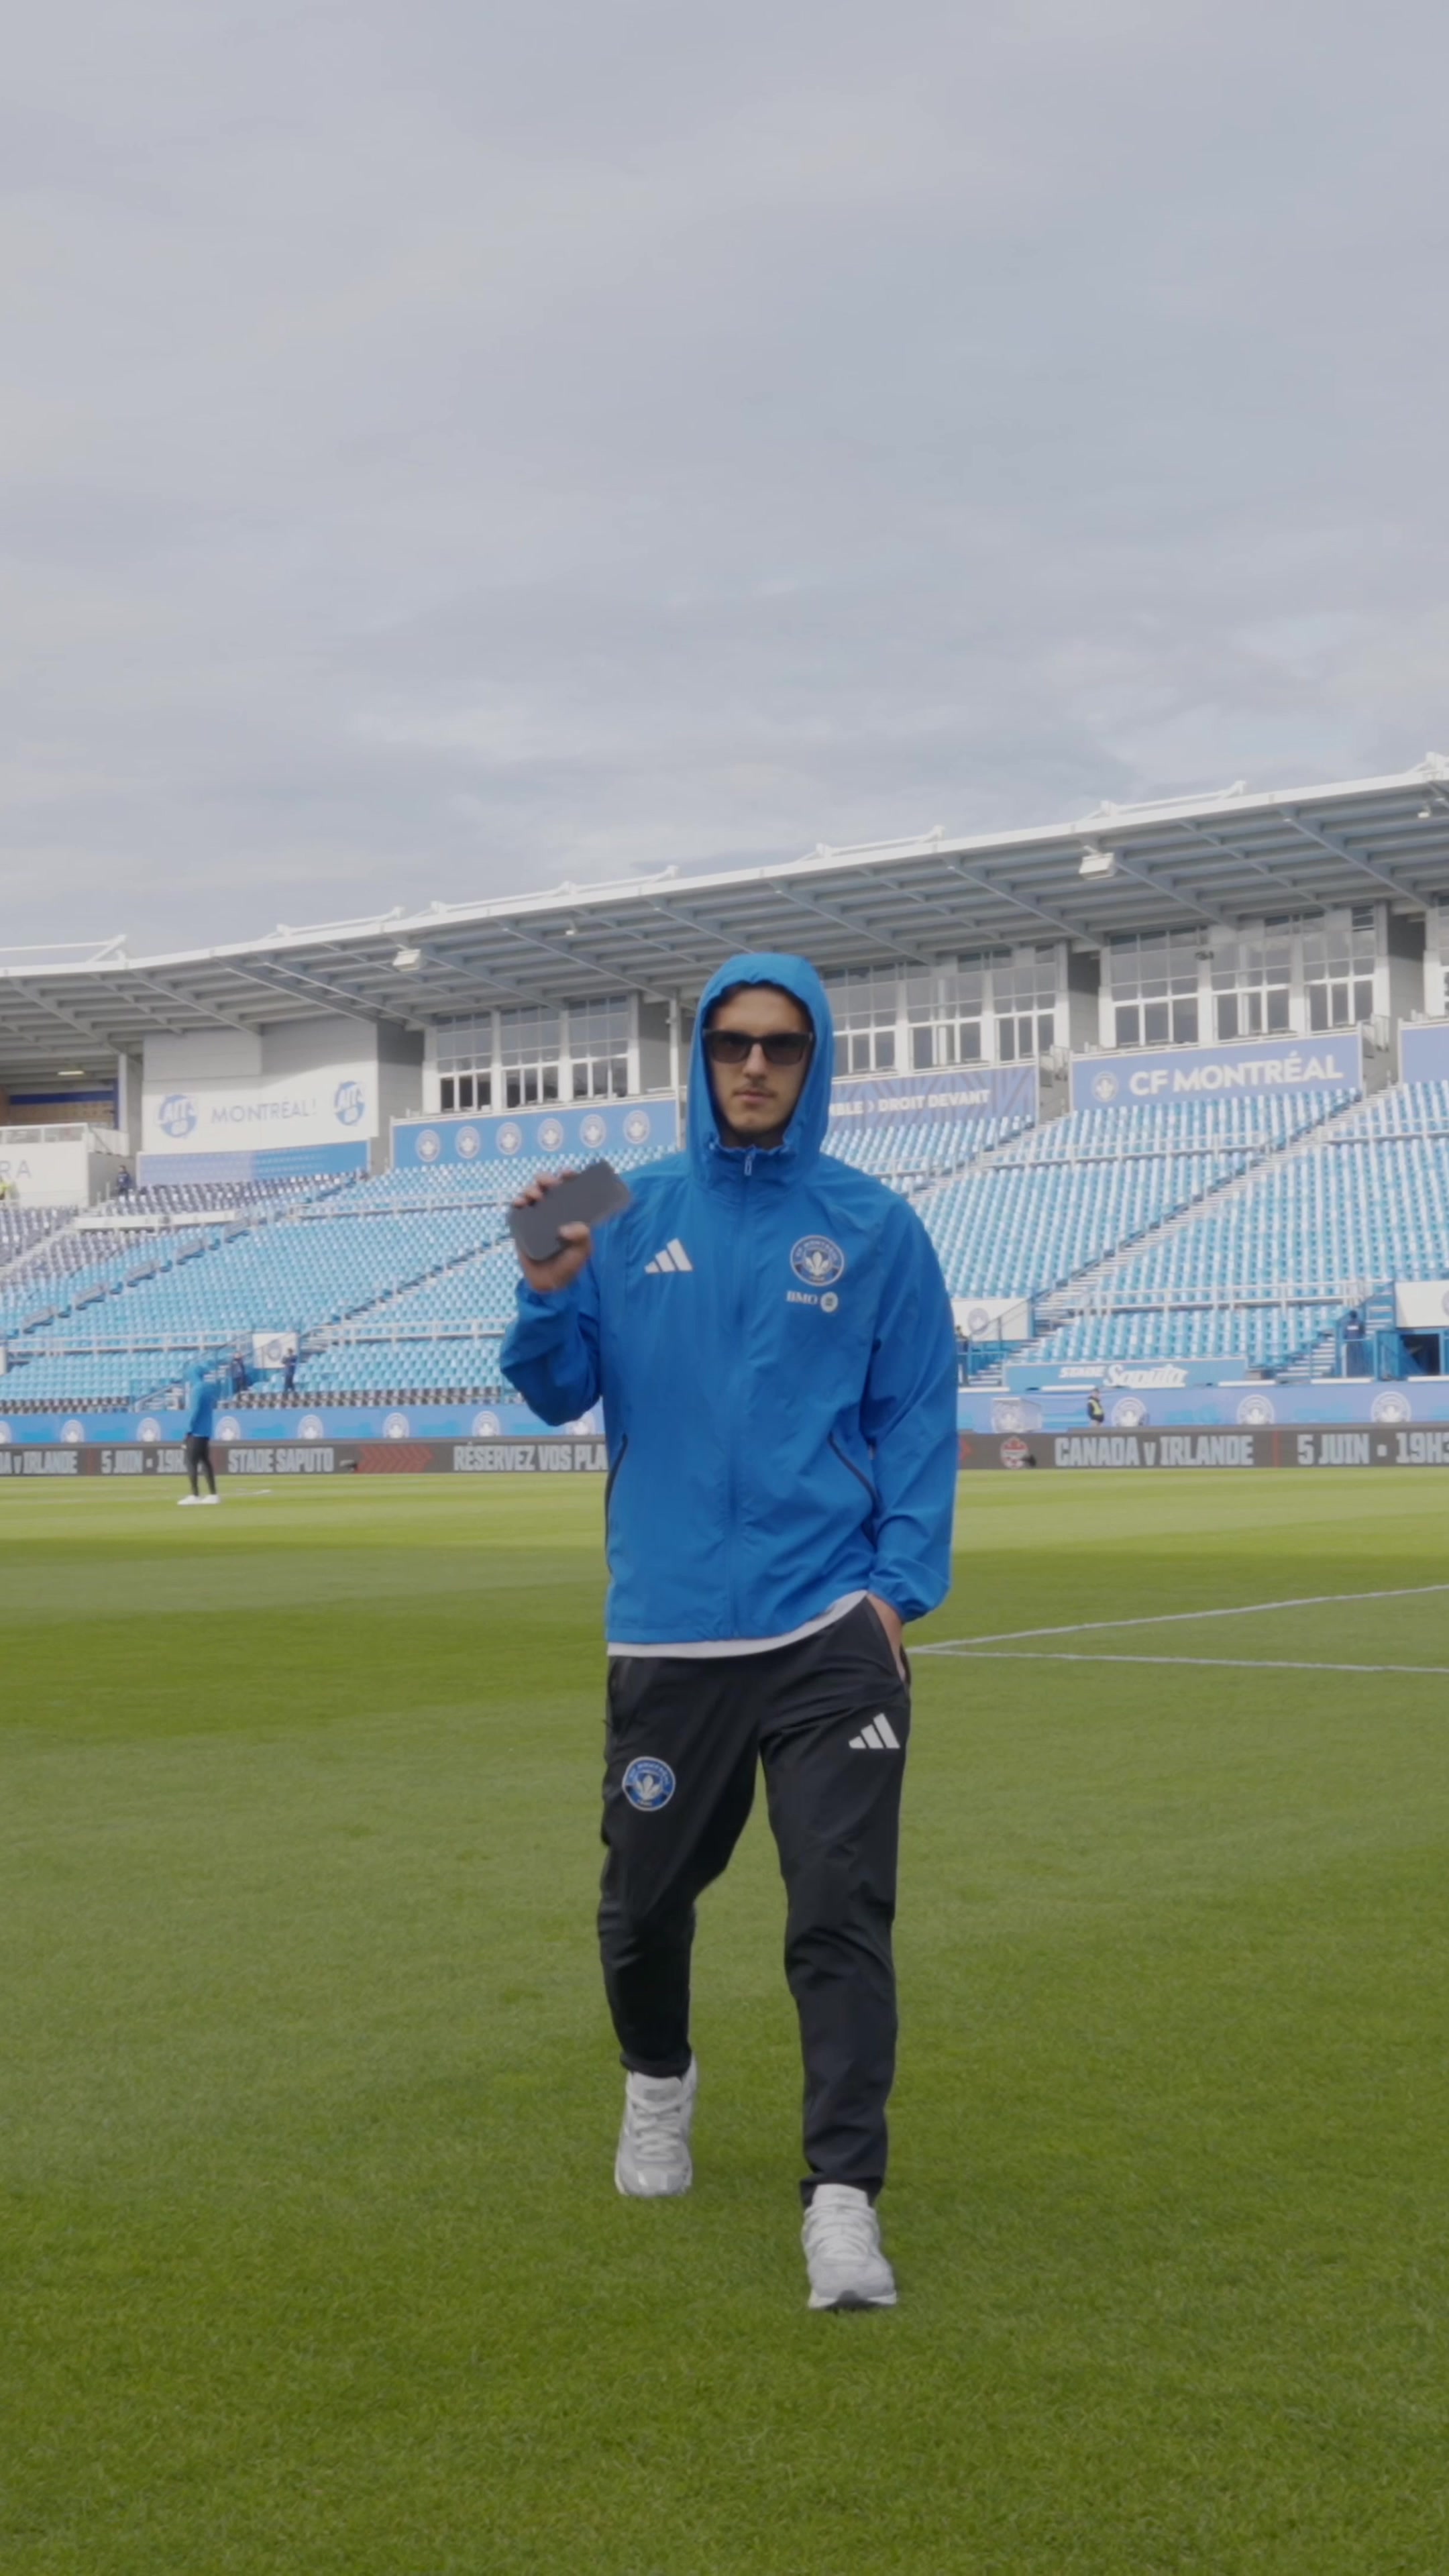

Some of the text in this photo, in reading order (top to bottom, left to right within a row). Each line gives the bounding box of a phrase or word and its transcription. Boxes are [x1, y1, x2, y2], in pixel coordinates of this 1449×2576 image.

[1129, 1051, 1344, 1095] CF MONTRÉAL
[879, 1095, 926, 1112] DROIT
[928, 1089, 990, 1107] DEVANT
[787, 1290, 818, 1305] BMO
[1059, 1366, 1106, 1379] STADE
[228, 1447, 334, 1472] STADE SAPUTO
[453, 1442, 535, 1470] RÉSERVEZ
[538, 1444, 571, 1470] VOS
[1055, 1436, 1140, 1466] CANADA
[1160, 1435, 1254, 1466] IRLANDE
[1297, 1434, 1314, 1465] 5
[1318, 1433, 1370, 1464] JUIN
[23, 1450, 78, 1474] IRLANDE
[101, 1450, 113, 1473] 5
[113, 1450, 143, 1473] JUIN
